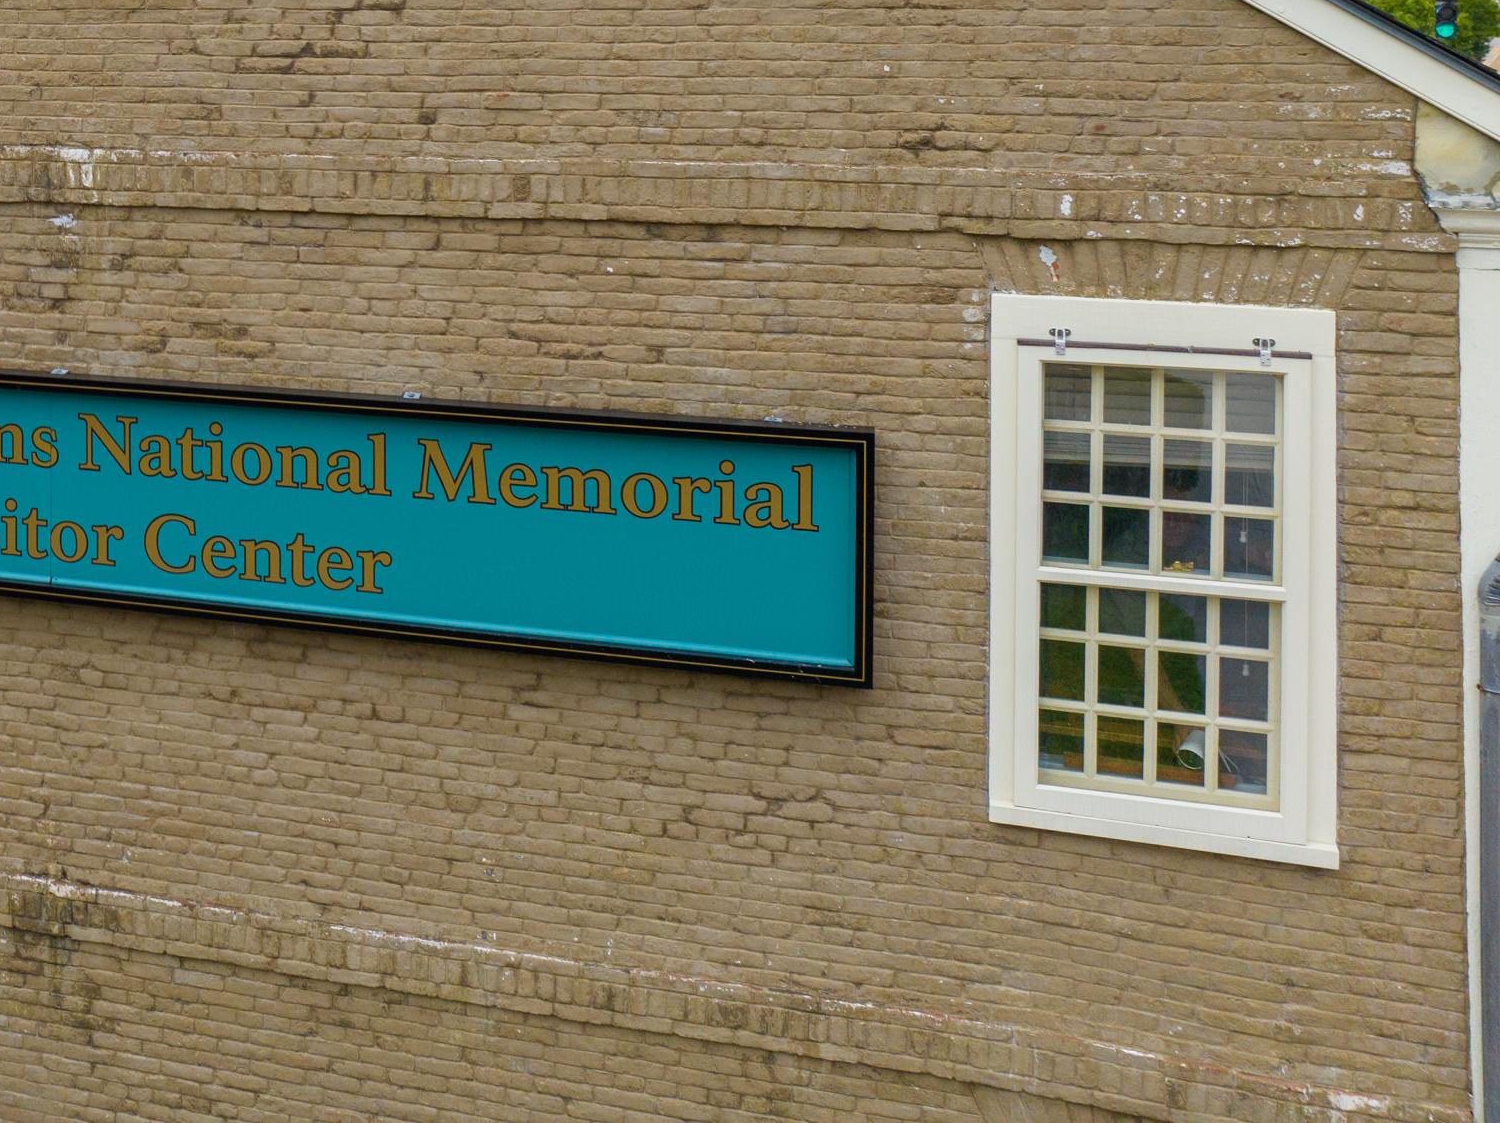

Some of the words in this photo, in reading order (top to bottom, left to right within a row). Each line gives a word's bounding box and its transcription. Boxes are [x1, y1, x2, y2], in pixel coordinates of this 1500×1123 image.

[76, 411, 393, 498] National
[411, 437, 821, 533] Memorial
[143, 513, 394, 595] Center
